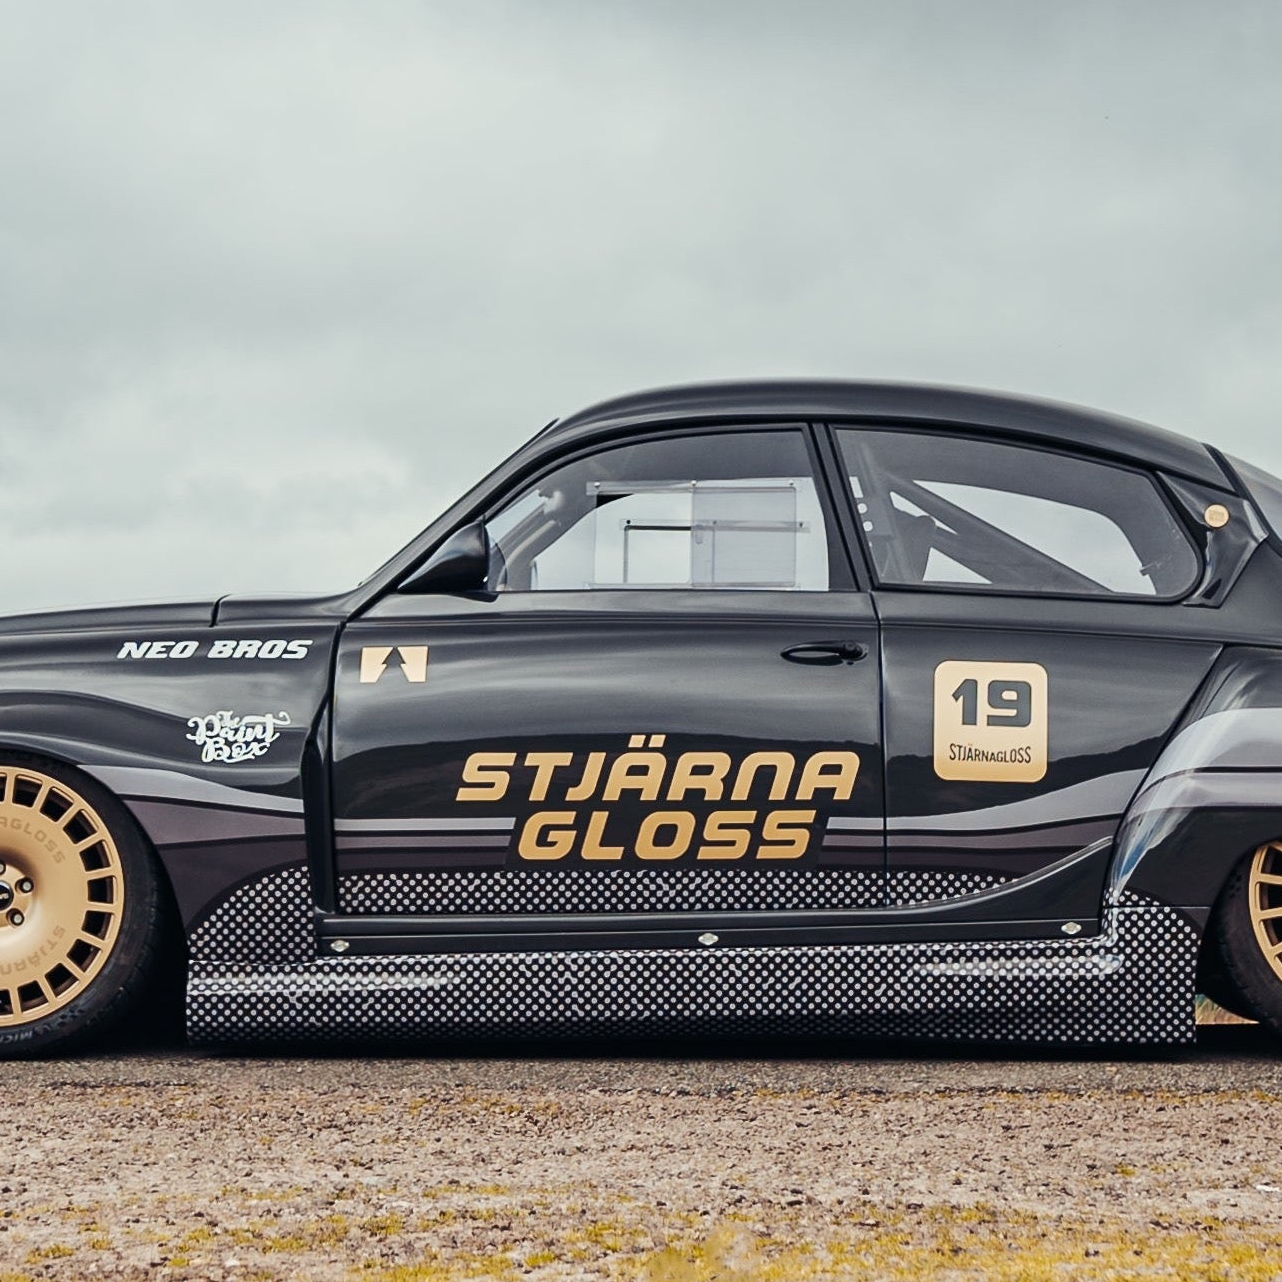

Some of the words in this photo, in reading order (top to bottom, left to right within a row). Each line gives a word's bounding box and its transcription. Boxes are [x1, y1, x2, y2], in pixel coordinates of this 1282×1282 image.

[116, 640, 200, 660] NEO
[207, 639, 314, 660] BROS
[951, 678, 1032, 728] 19
[186, 711, 292, 746] Paint
[201, 737, 271, 764] Box
[455, 734, 861, 802] STJÄRNA
[517, 809, 817, 860] GLOSS
